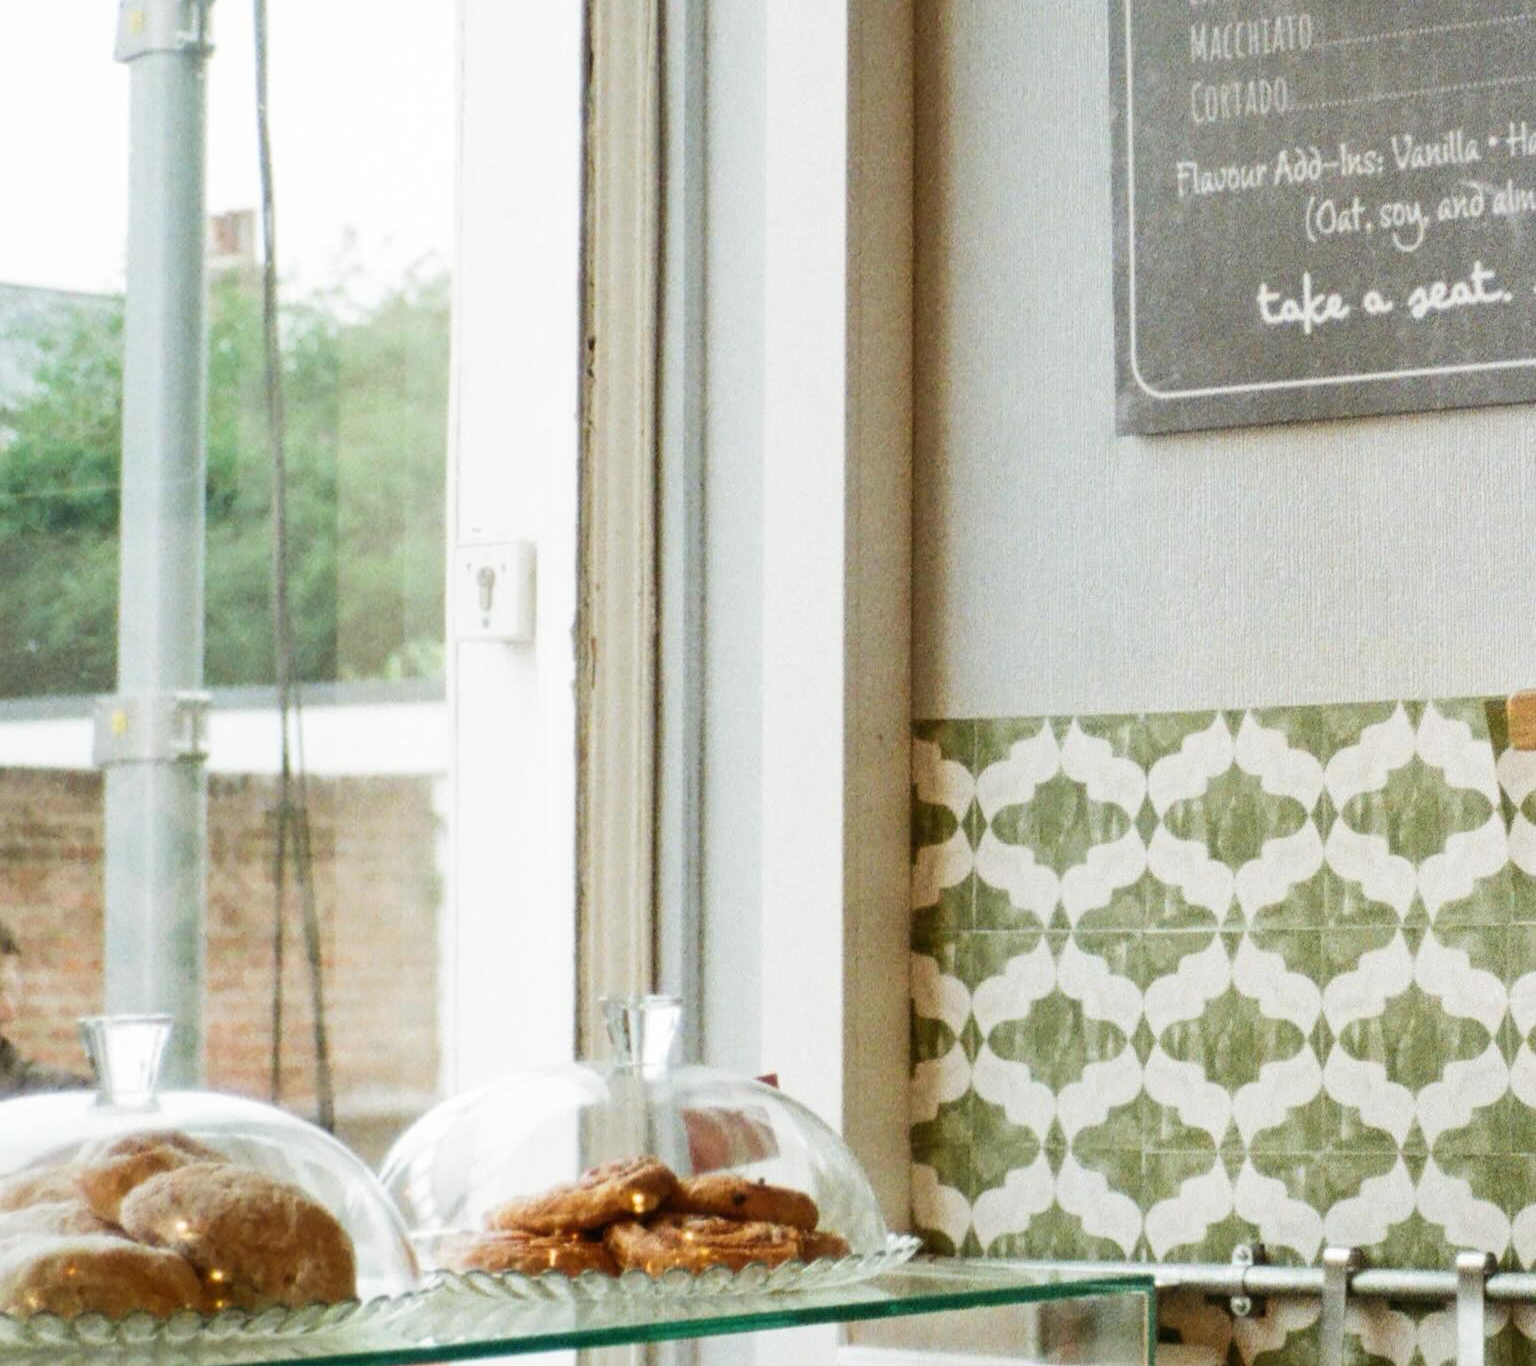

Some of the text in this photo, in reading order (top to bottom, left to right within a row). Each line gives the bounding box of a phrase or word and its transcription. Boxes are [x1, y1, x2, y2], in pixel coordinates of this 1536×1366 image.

[1189, 13, 1313, 64] MACCHIATO
[1190, 77, 1289, 125] CORTADO
[1177, 160, 1267, 198] Flavour
[1391, 129, 1481, 171] Vanilla
[1438, 181, 1484, 222] and
[1256, 271, 1350, 333] take
[1363, 289, 1394, 315] a
